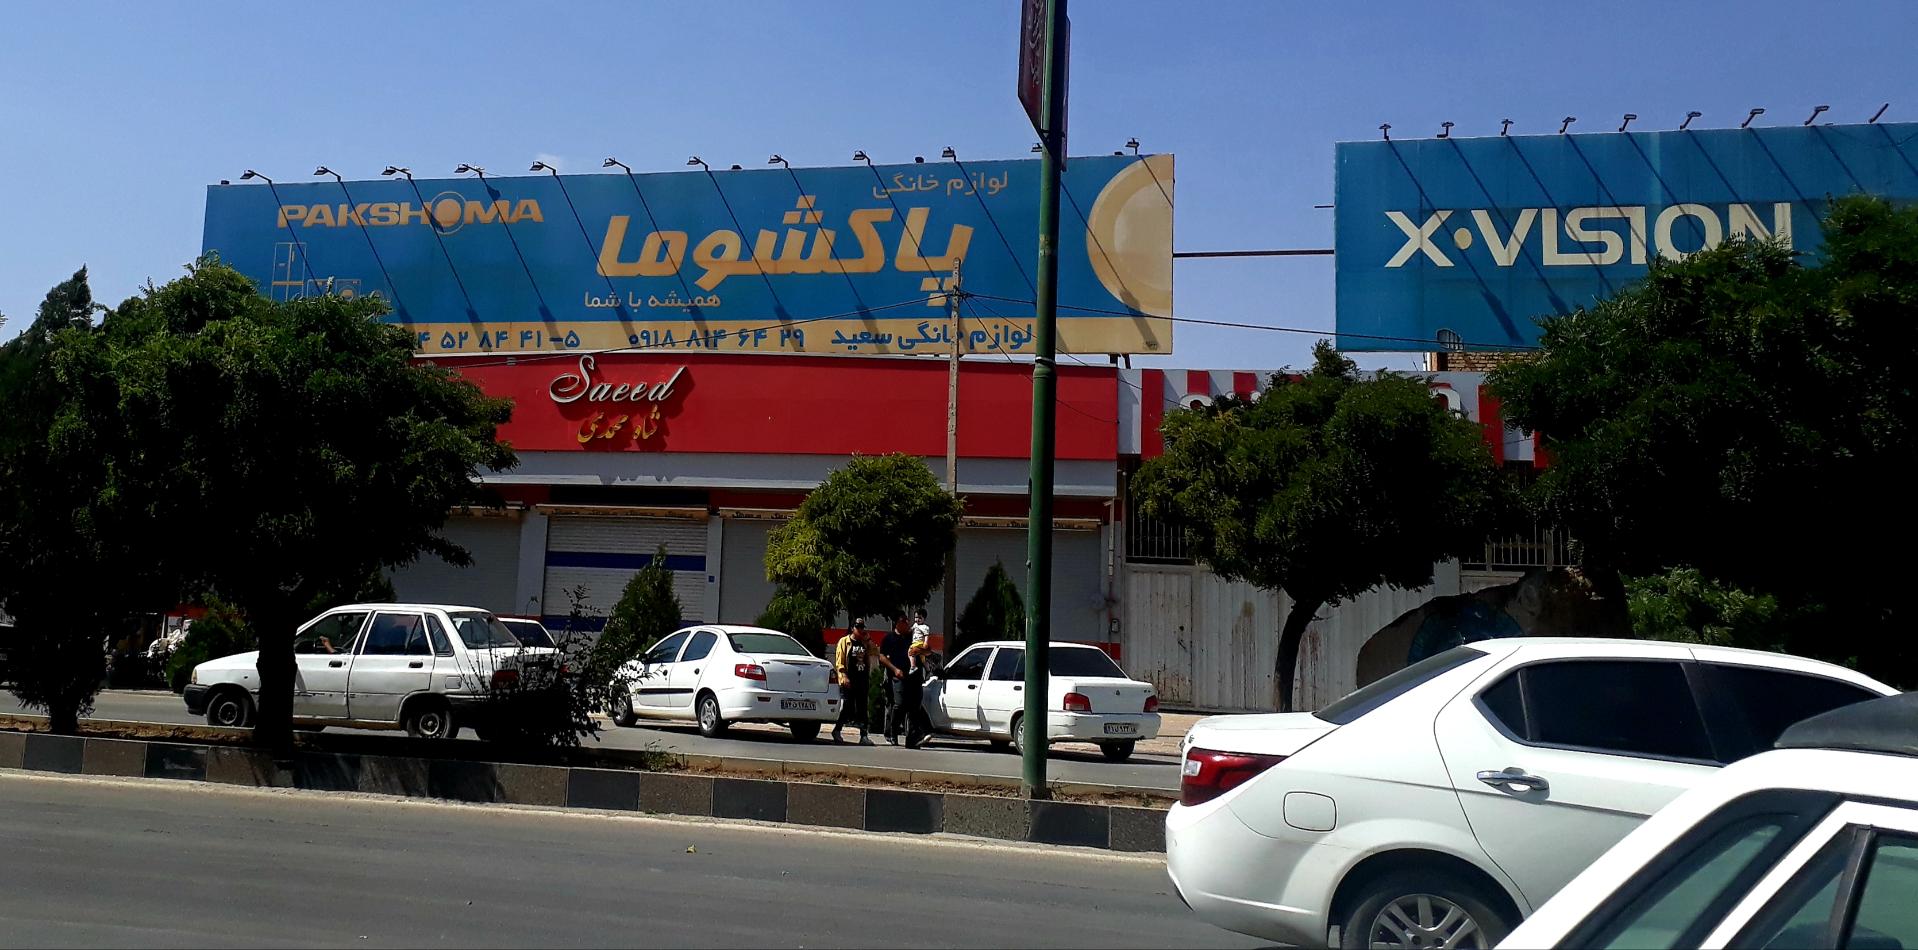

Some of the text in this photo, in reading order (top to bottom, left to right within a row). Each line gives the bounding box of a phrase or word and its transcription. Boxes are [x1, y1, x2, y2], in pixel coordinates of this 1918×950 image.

[872, 171, 1008, 199] لوازم خانگی
[277, 193, 545, 233] PAKSHOMA
[596, 195, 974, 306] پاکشوما
[584, 290, 721, 313] همیشه با شما
[628, 329, 677, 348] ۰۹۱۸
[831, 329, 893, 351] سعید
[969, 323, 1032, 350] لوازم
[549, 354, 688, 403] Saeed
[632, 404, 661, 440] شاه
